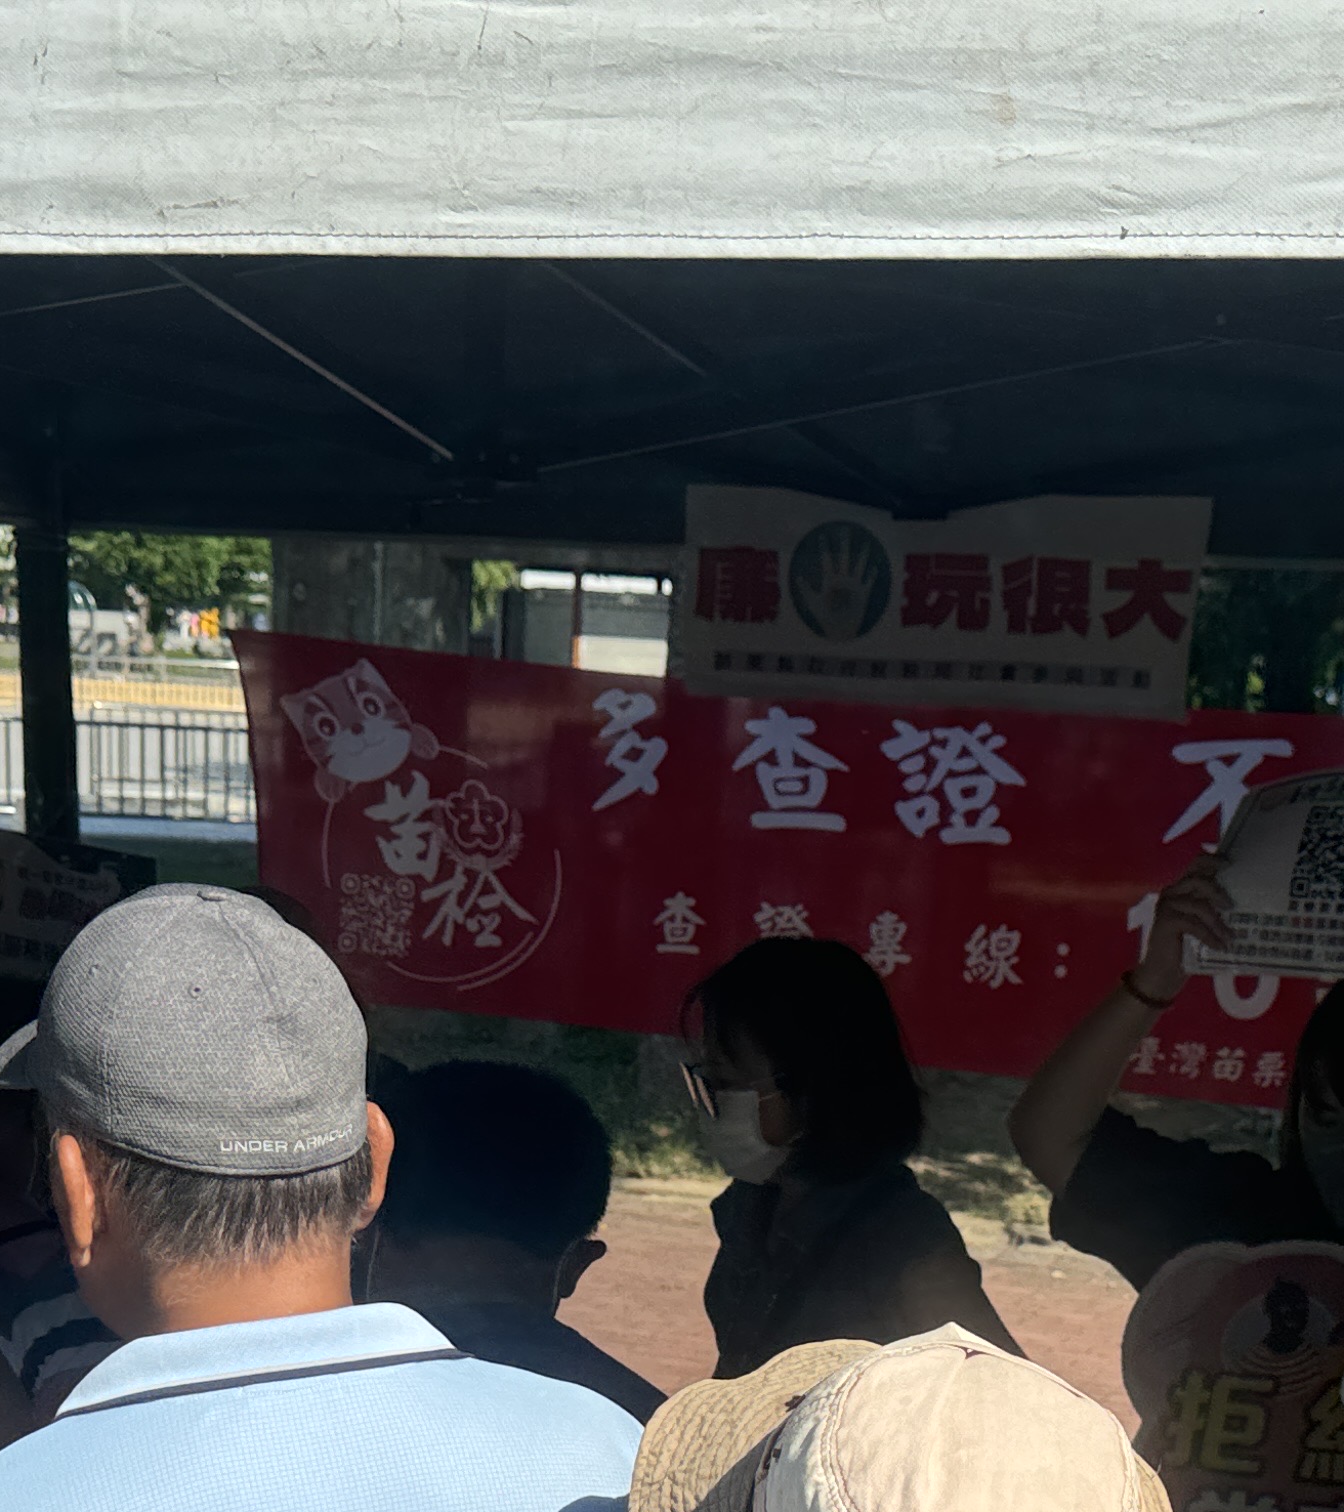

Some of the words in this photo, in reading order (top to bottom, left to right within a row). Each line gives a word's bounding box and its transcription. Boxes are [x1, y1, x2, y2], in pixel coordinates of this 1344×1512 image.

[591, 687, 1029, 847] 多查證
[219, 1140, 289, 1153] UNDER
[293, 1124, 354, 1152] ARMOUR
